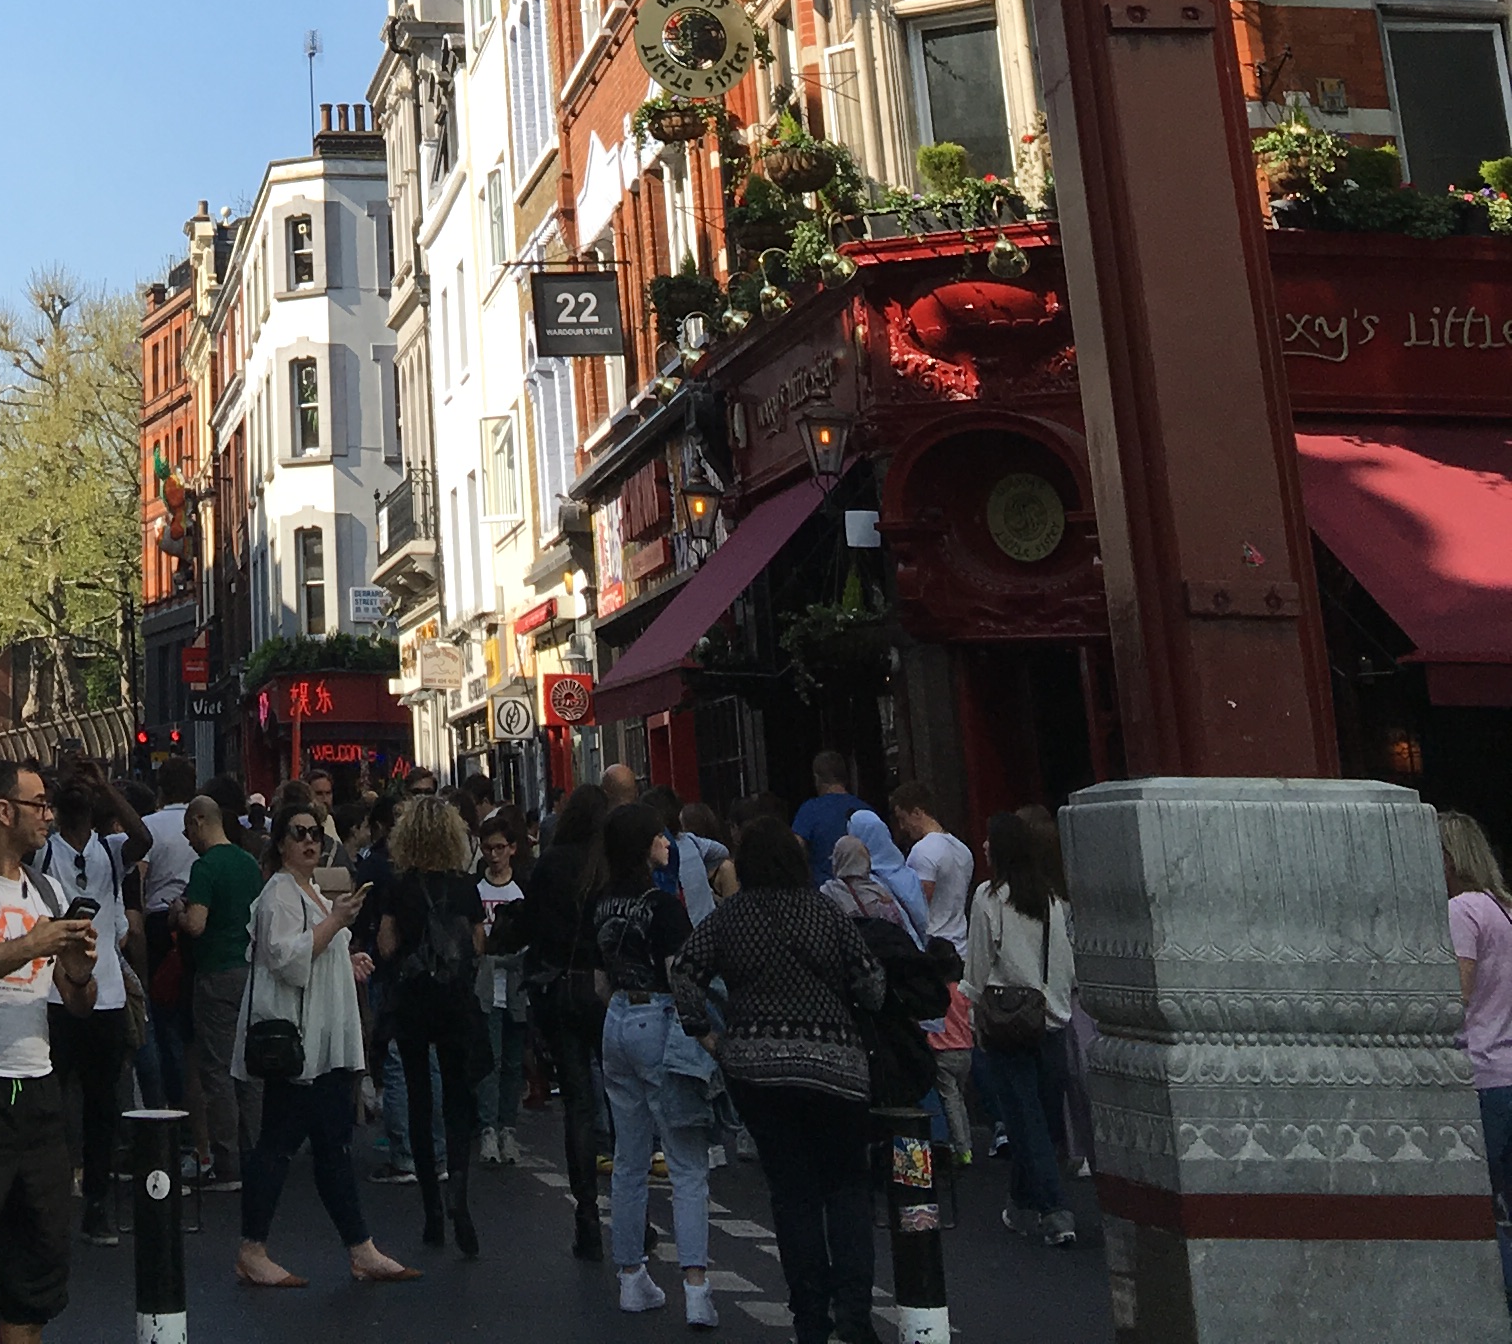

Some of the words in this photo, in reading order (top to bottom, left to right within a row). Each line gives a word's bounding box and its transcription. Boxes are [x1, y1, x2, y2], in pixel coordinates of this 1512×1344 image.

[556, 292, 600, 323] 22
[546, 328, 584, 336] WARDOUR
[585, 327, 613, 335] STREET
[1284, 308, 1380, 362] xy's
[192, 698, 223, 715] Viet
